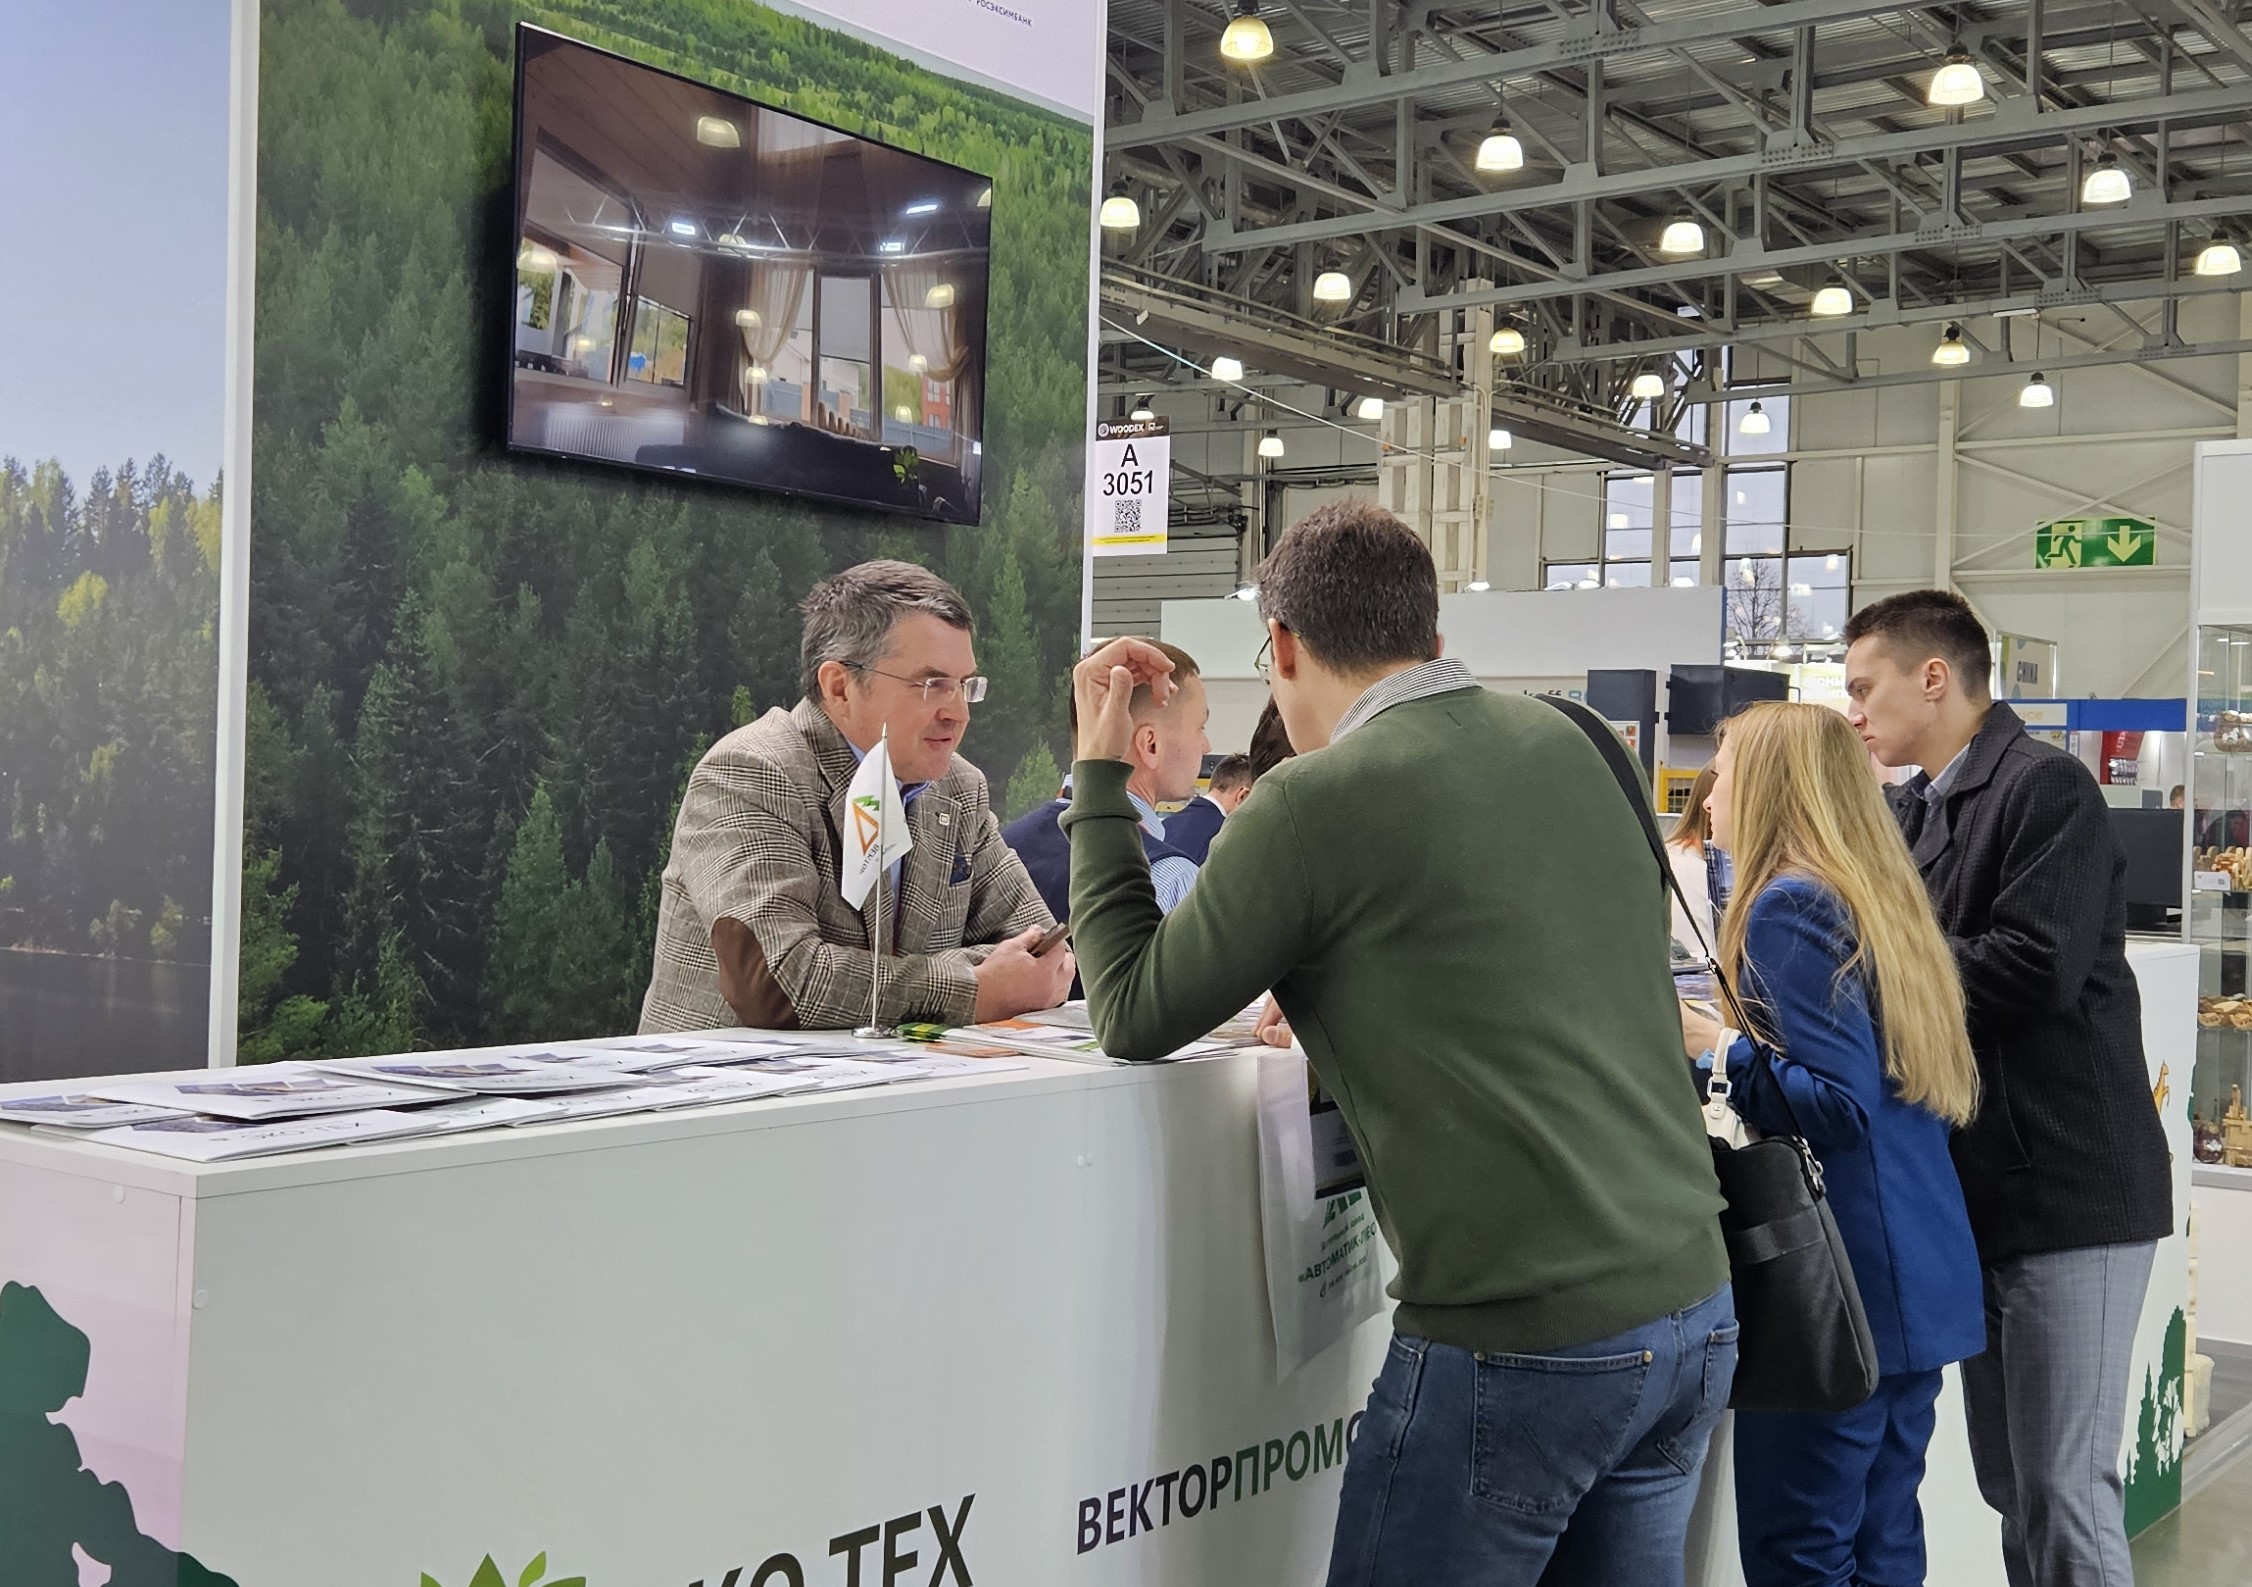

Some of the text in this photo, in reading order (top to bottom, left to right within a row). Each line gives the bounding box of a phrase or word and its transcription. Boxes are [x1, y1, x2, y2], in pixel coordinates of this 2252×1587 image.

[1109, 423, 1144, 434] WOODEX
[1120, 443, 1139, 468] A
[1102, 470, 1154, 496] 3051
